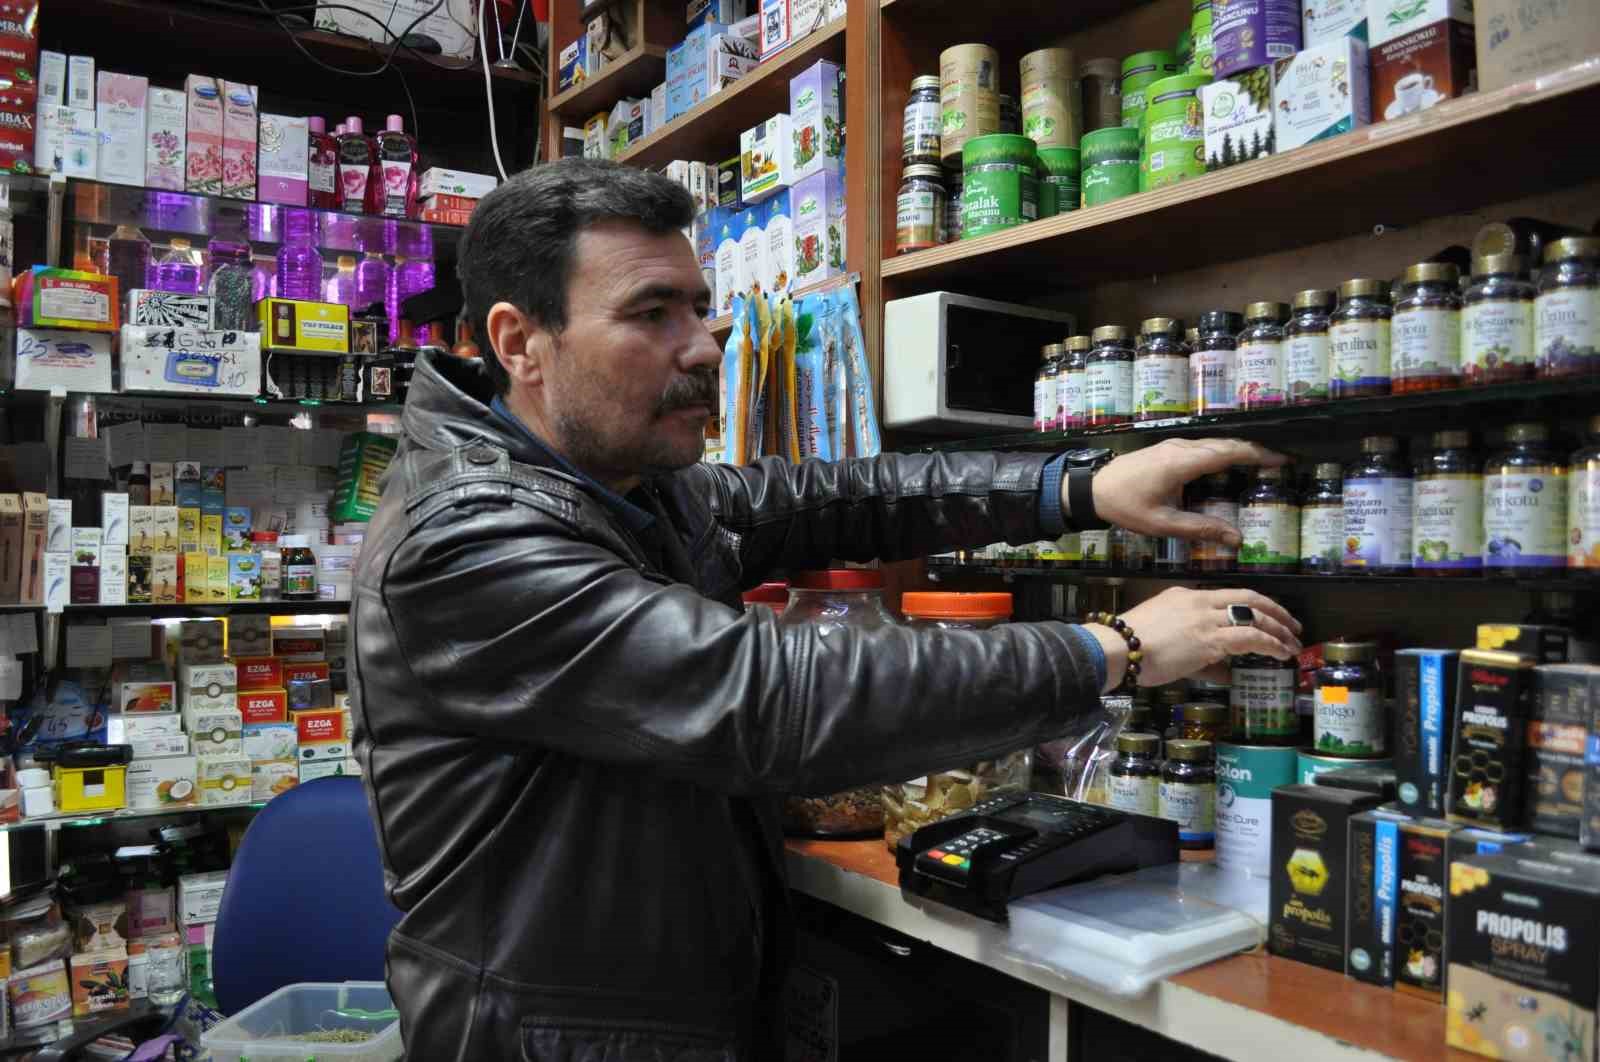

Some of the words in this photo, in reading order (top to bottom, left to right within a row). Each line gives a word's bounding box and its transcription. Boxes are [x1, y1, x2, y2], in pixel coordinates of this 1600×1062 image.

[249, 699, 275, 710] EZGA
[307, 719, 332, 729] EZGA
[1476, 910, 1566, 951] PROPOLIS
